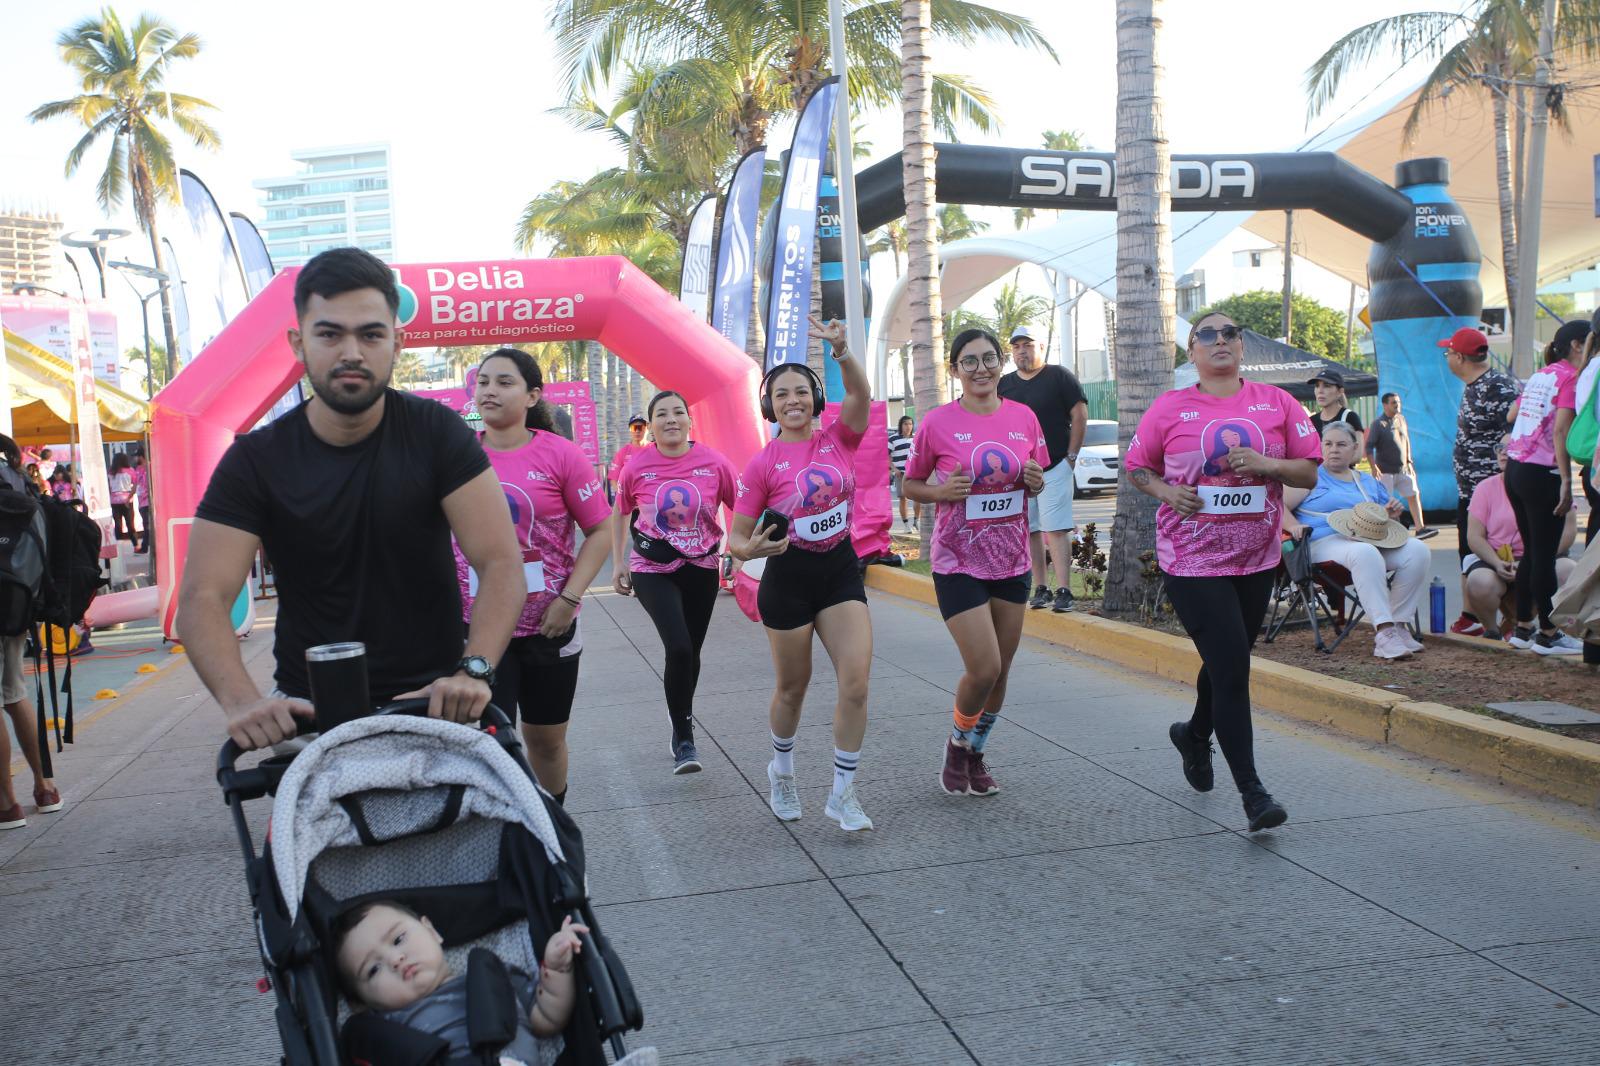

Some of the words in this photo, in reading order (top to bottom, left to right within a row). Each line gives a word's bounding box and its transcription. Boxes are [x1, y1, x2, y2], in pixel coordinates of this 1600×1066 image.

[1020, 155, 1255, 198] SADA
[1415, 214, 1468, 226] POWER
[427, 267, 525, 292] Delia
[773, 224, 801, 366] CERRITOS
[434, 329, 467, 340] para
[470, 327, 486, 337] tu
[489, 322, 575, 336] diagnóstico
[1239, 359, 1322, 371] WERADE
[981, 497, 1013, 512] 1037
[1212, 493, 1252, 507] 1000
[810, 512, 842, 534] 0883
